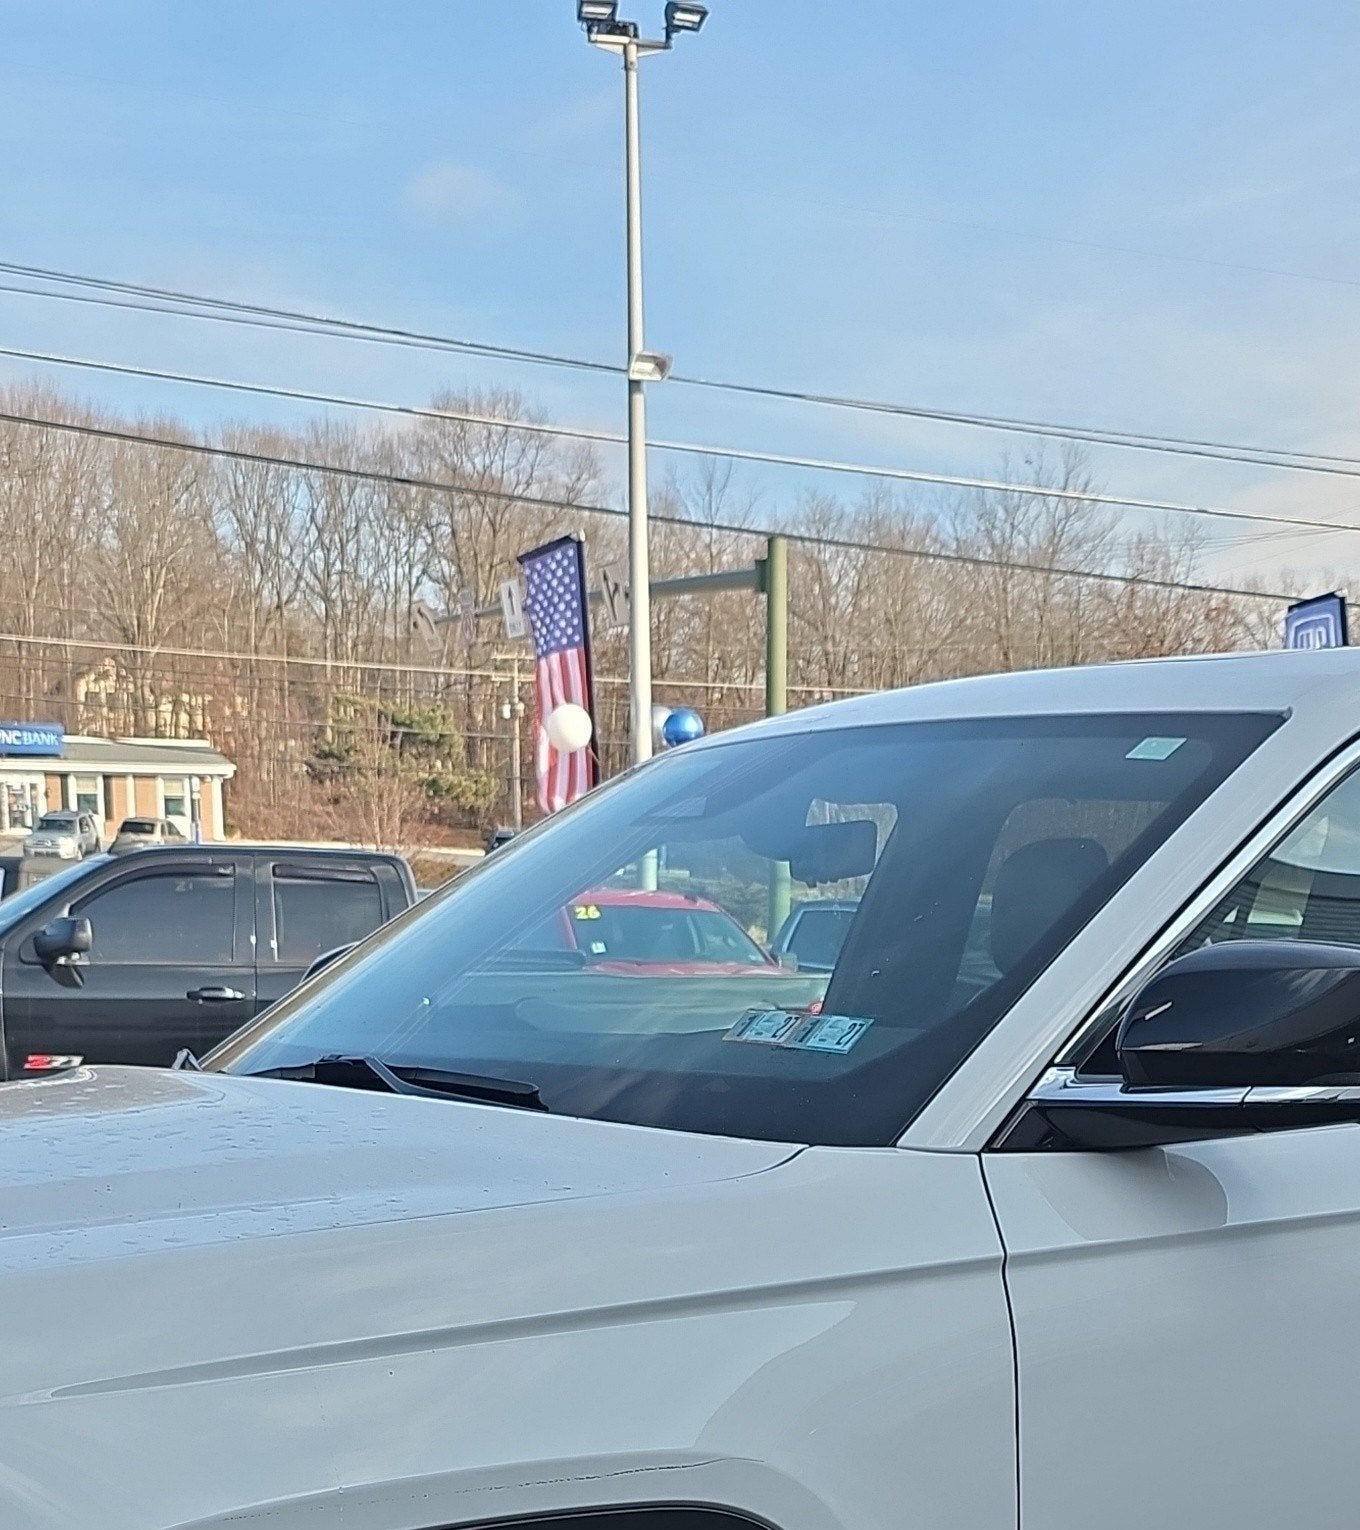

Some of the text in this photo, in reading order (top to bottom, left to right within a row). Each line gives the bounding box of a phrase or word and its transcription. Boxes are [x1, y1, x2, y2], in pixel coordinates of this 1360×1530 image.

[22, 731, 59, 746] BANK
[575, 905, 601, 919] 26
[771, 1017, 799, 1040] 27
[836, 1023, 865, 1047] 27
[23, 1054, 85, 1070] Z71
